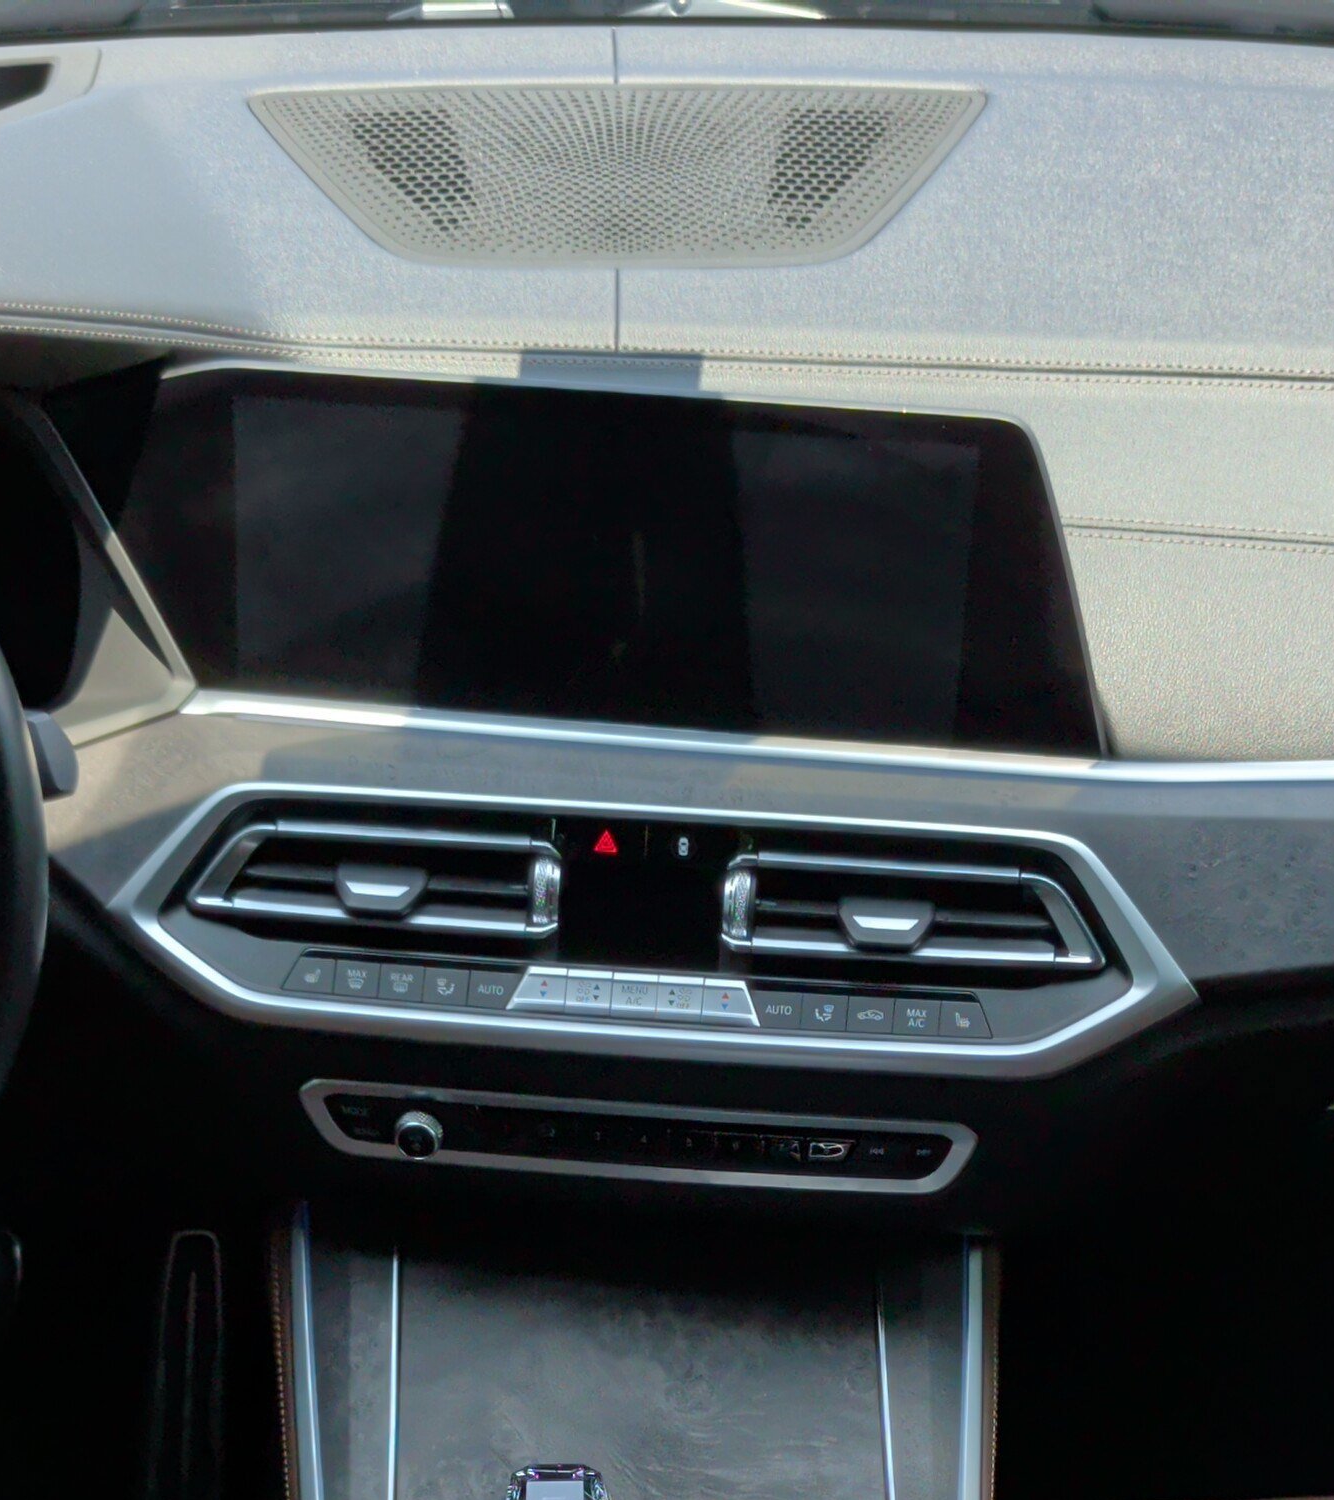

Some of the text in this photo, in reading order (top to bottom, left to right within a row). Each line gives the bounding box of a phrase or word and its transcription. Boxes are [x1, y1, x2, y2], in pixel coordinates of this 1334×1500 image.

[347, 968, 367, 979] MAX
[390, 973, 414, 983] REAR
[478, 983, 504, 996] AUTO
[621, 985, 648, 995] MENU
[625, 996, 643, 1007] A/C
[676, 1001, 691, 1010] OFF
[765, 1004, 792, 1016] AUTO
[906, 1008, 927, 1019] MAX
[908, 1018, 924, 1029] A/C
